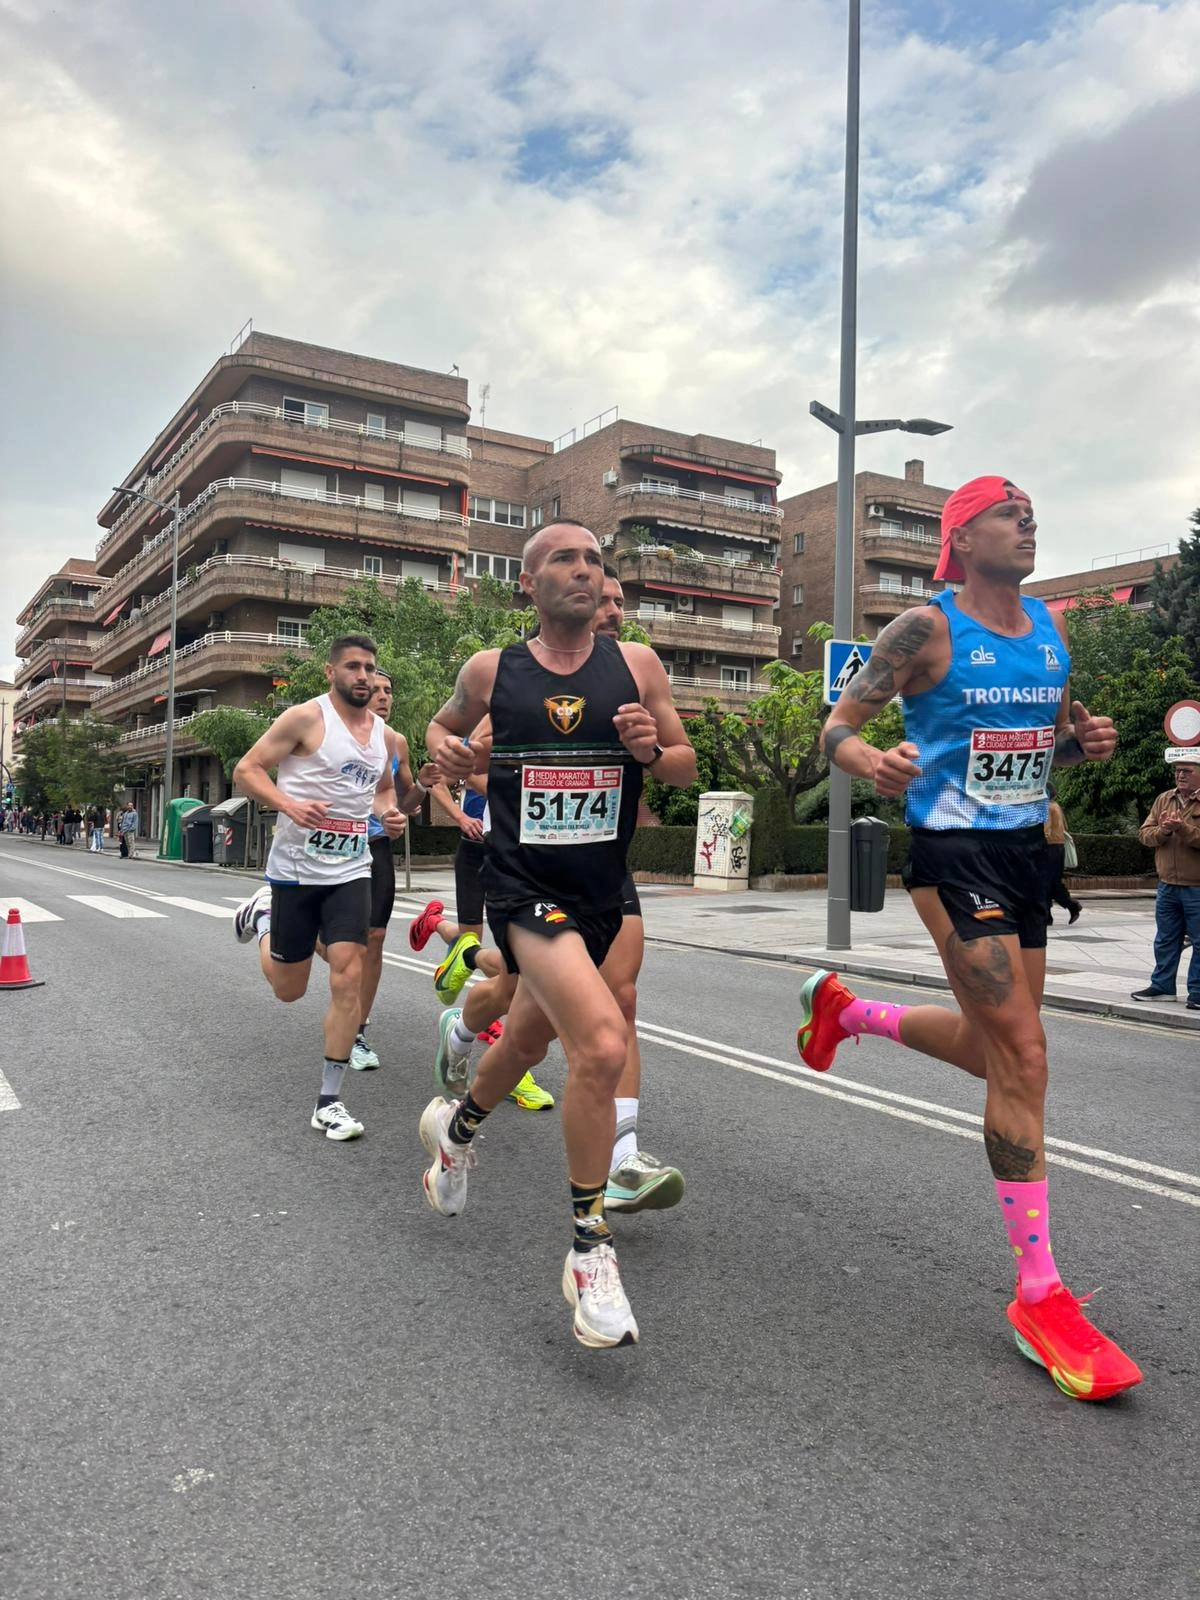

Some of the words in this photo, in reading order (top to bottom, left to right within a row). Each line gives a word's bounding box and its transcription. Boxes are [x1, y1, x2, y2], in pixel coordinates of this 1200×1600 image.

[962, 687, 1064, 705] TROTASIERR
[987, 733, 1008, 741] MEDIA
[535, 772, 557, 780] MEDIA
[558, 770, 590, 780] MARATÓN
[974, 752, 1046, 781] 3475
[527, 791, 608, 821] 5174
[308, 830, 360, 852] 4271
